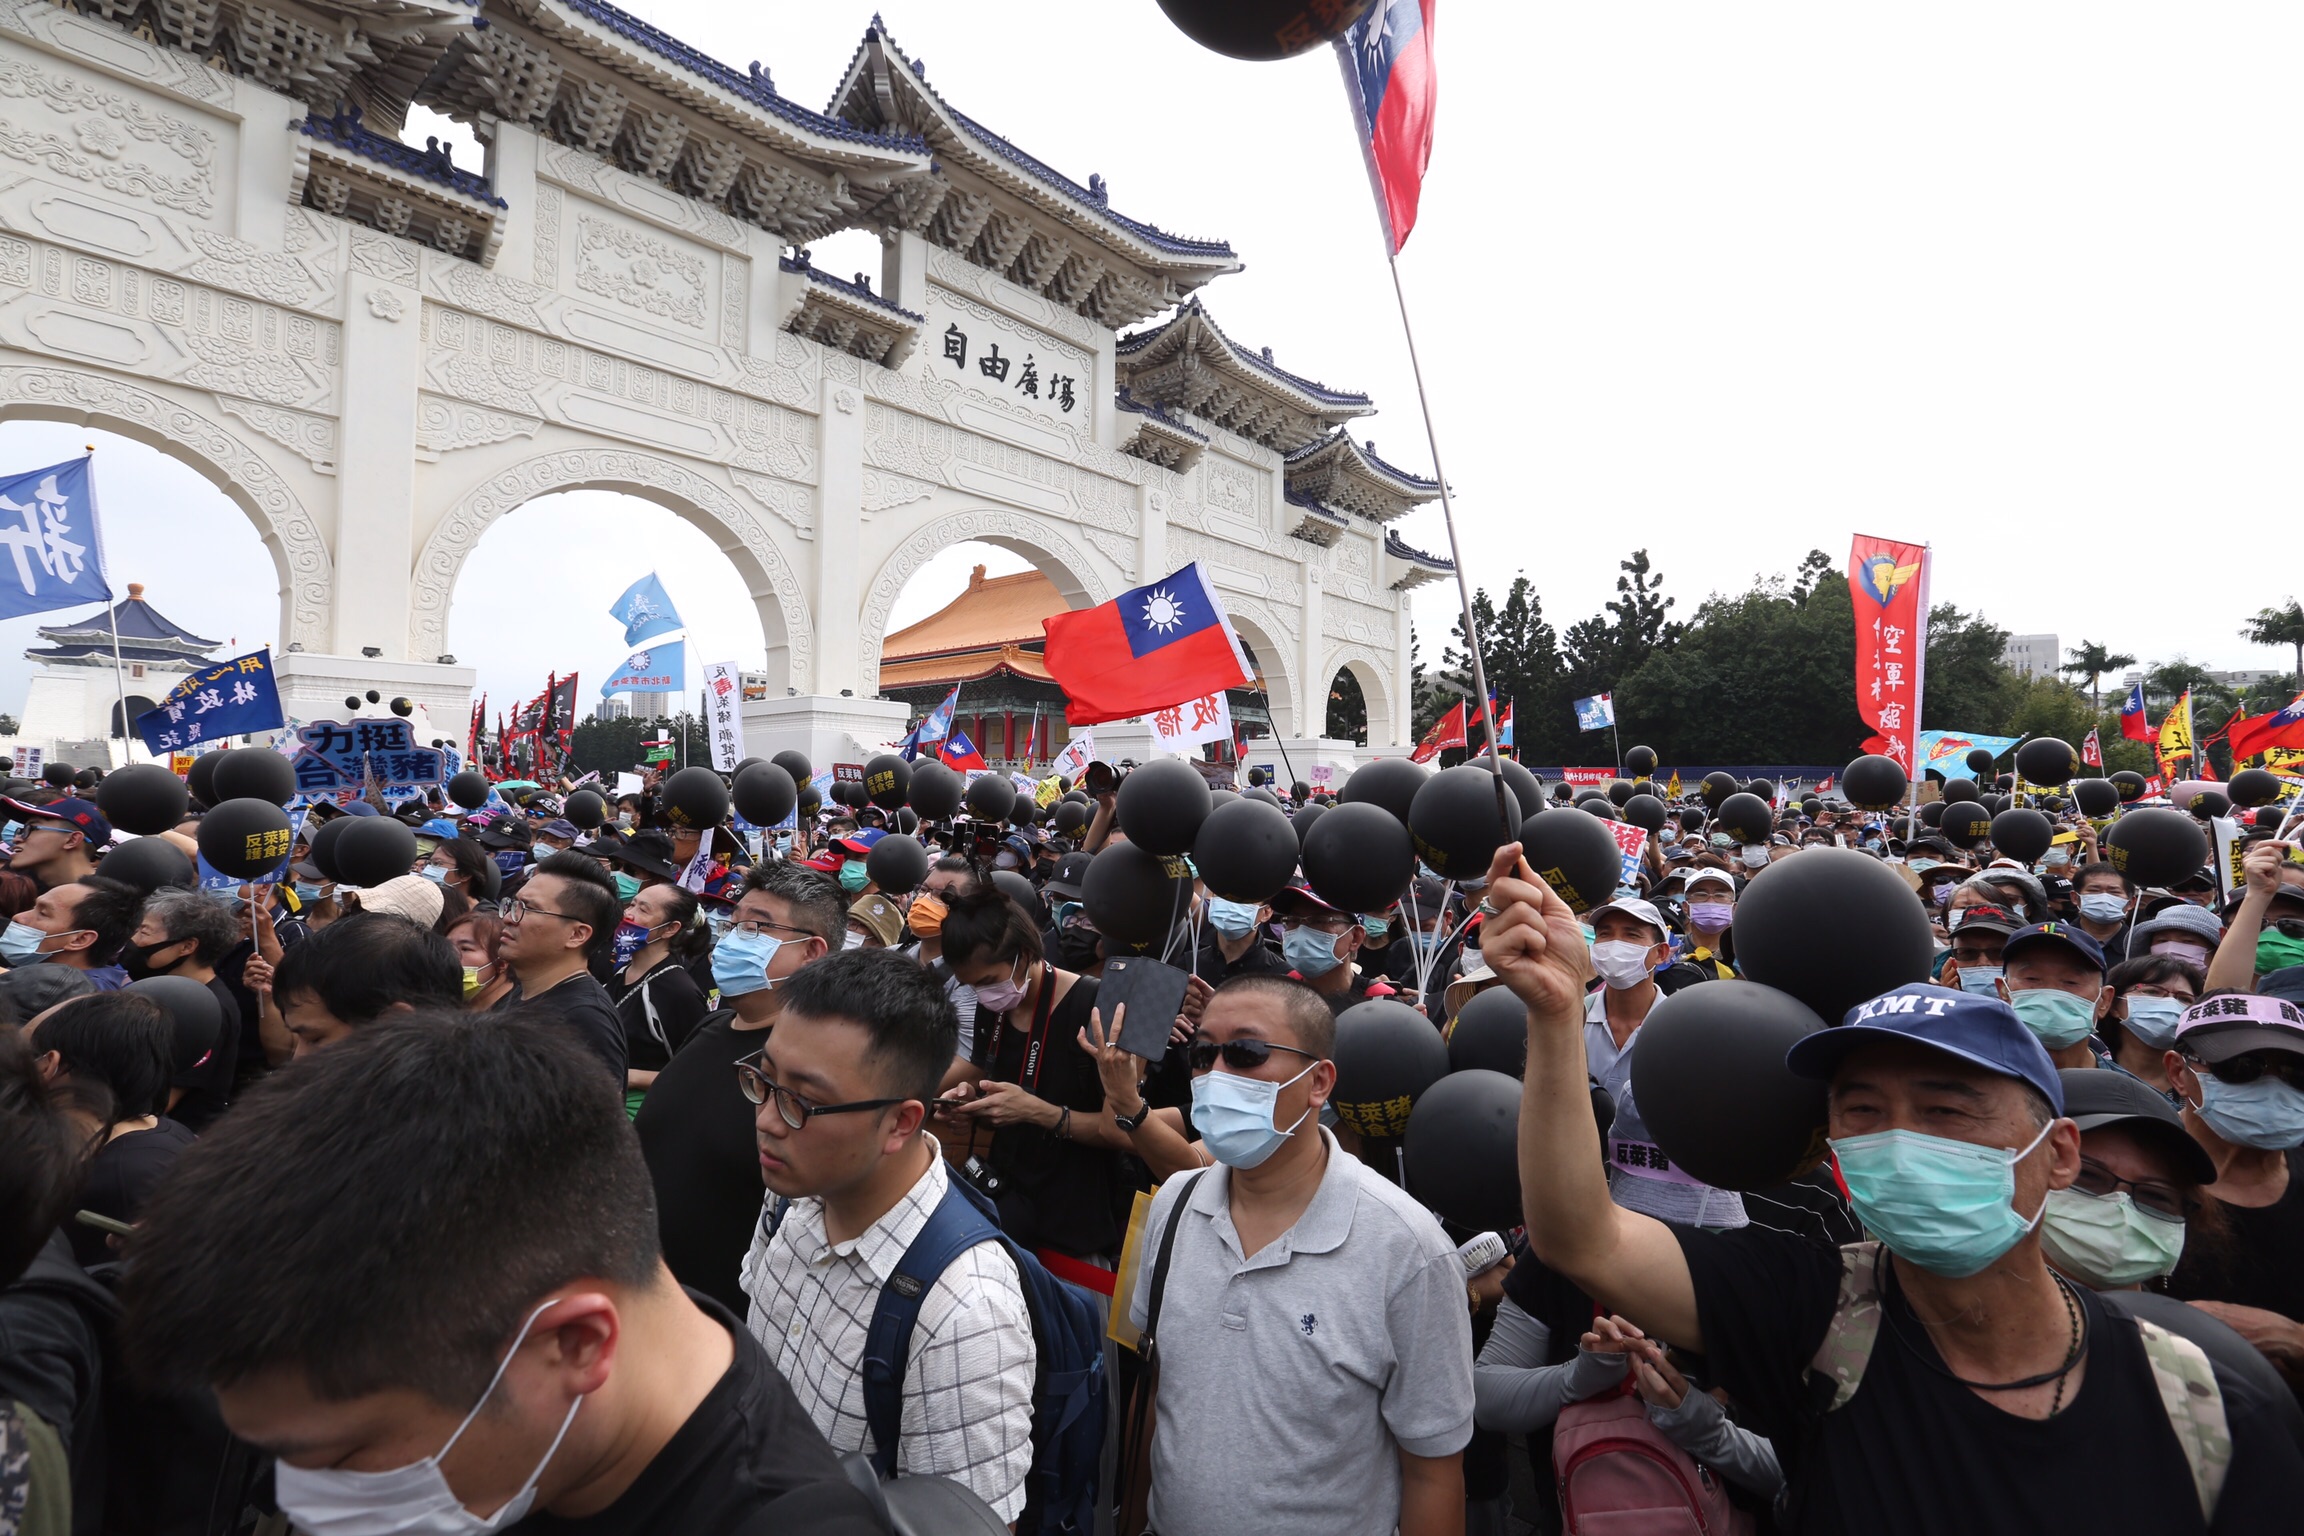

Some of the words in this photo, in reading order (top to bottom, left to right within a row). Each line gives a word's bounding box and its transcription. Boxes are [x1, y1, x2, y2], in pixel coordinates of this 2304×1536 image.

[944, 322, 1076, 412] 自由廣場
[309, 724, 407, 754] 力挺
[296, 751, 437, 789] 台灣豬
[837, 767, 863, 780] 反萊豬
[867, 770, 894, 786] 反萊豬
[246, 828, 289, 849] 反萊豬
[246, 843, 289, 861] 護食安
[1853, 995, 1957, 1026] KMT
[2186, 998, 2249, 1023] 反萊豬
[1026, 1041, 1041, 1076] Canon
[1336, 1095, 1412, 1122] 反萊豬
[1617, 1143, 1670, 1171] 反萊豬
